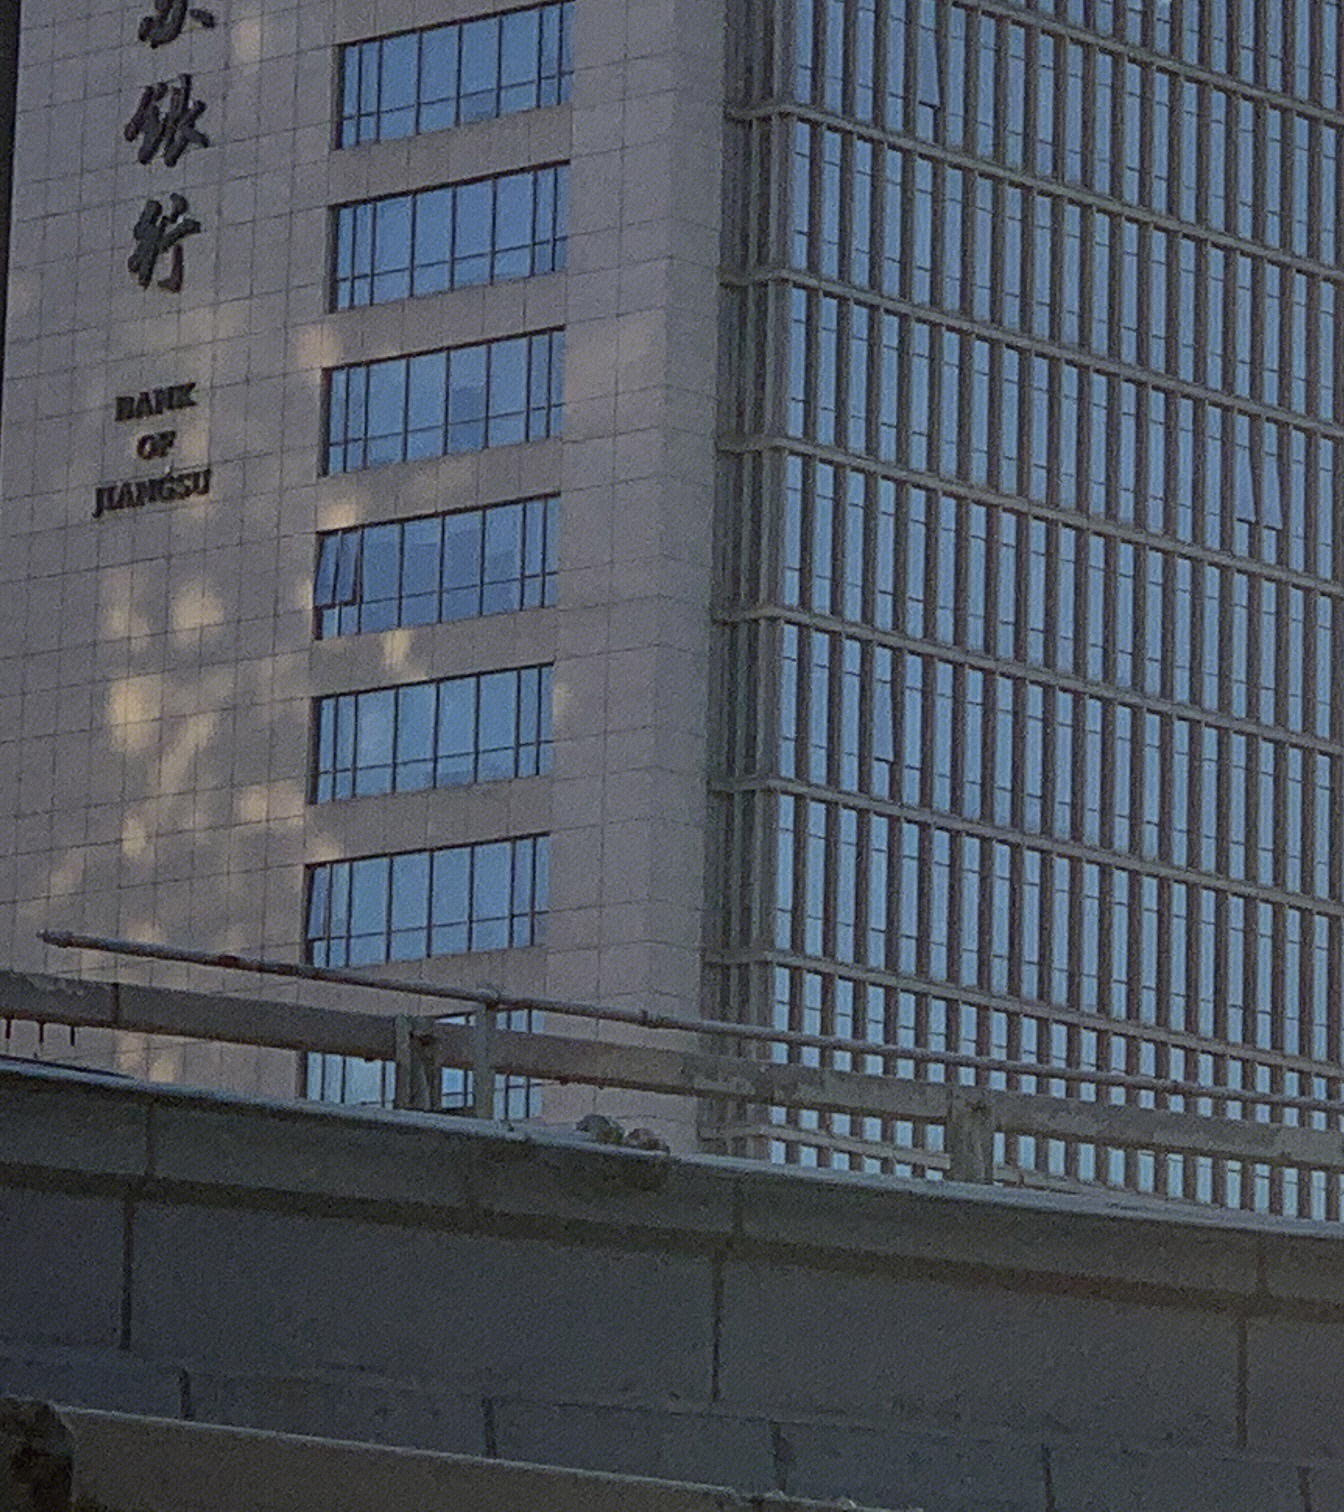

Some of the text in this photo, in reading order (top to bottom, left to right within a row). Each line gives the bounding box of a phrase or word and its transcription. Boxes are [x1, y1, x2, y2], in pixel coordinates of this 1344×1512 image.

[115, 382, 197, 423] BANK
[137, 430, 177, 460] OF
[92, 468, 212, 519] JIANGSU
